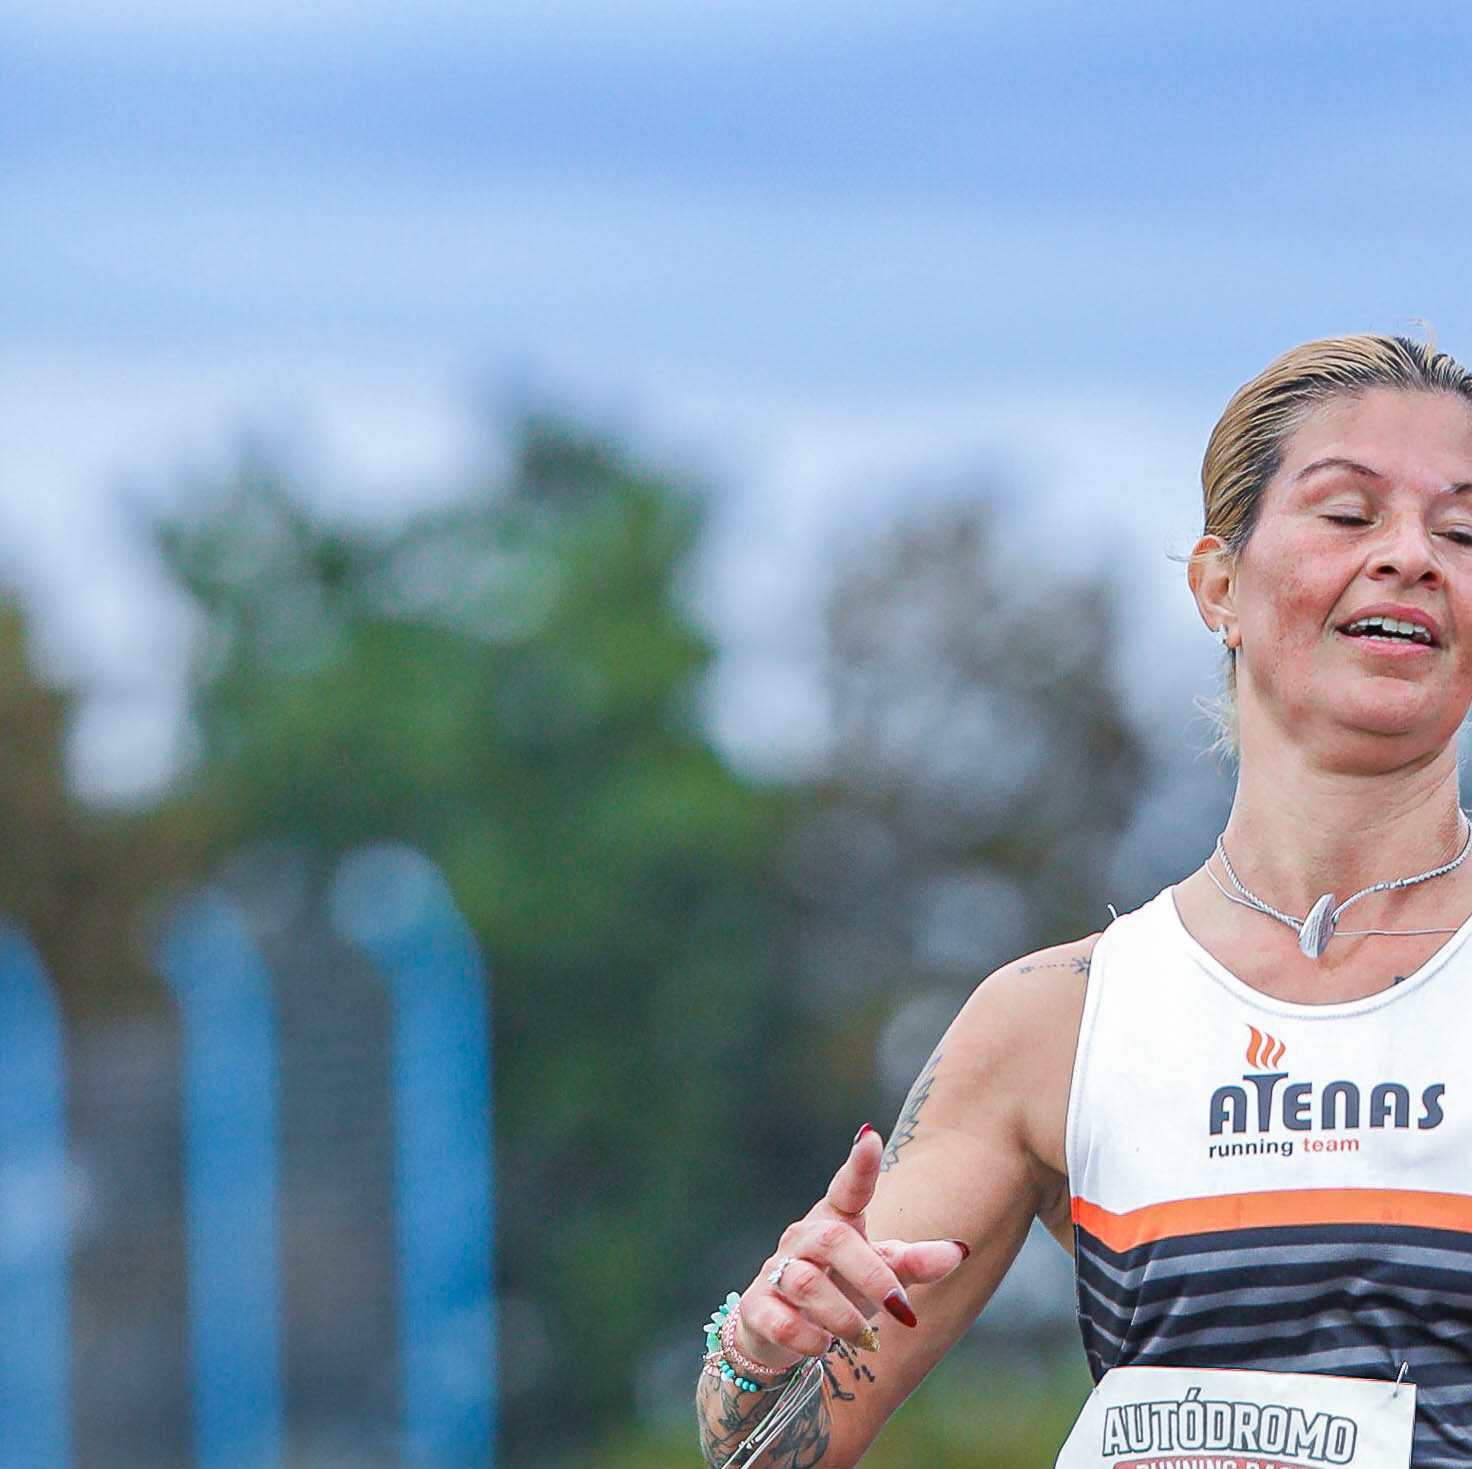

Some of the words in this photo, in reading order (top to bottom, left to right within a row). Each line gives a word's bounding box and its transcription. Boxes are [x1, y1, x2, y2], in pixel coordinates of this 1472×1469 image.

[1209, 1072, 1445, 1135] ATENAS
[1209, 1138, 1294, 1159] running
[1303, 1138, 1360, 1153] team
[1102, 1387, 1357, 1465] AUTÓDROMO
